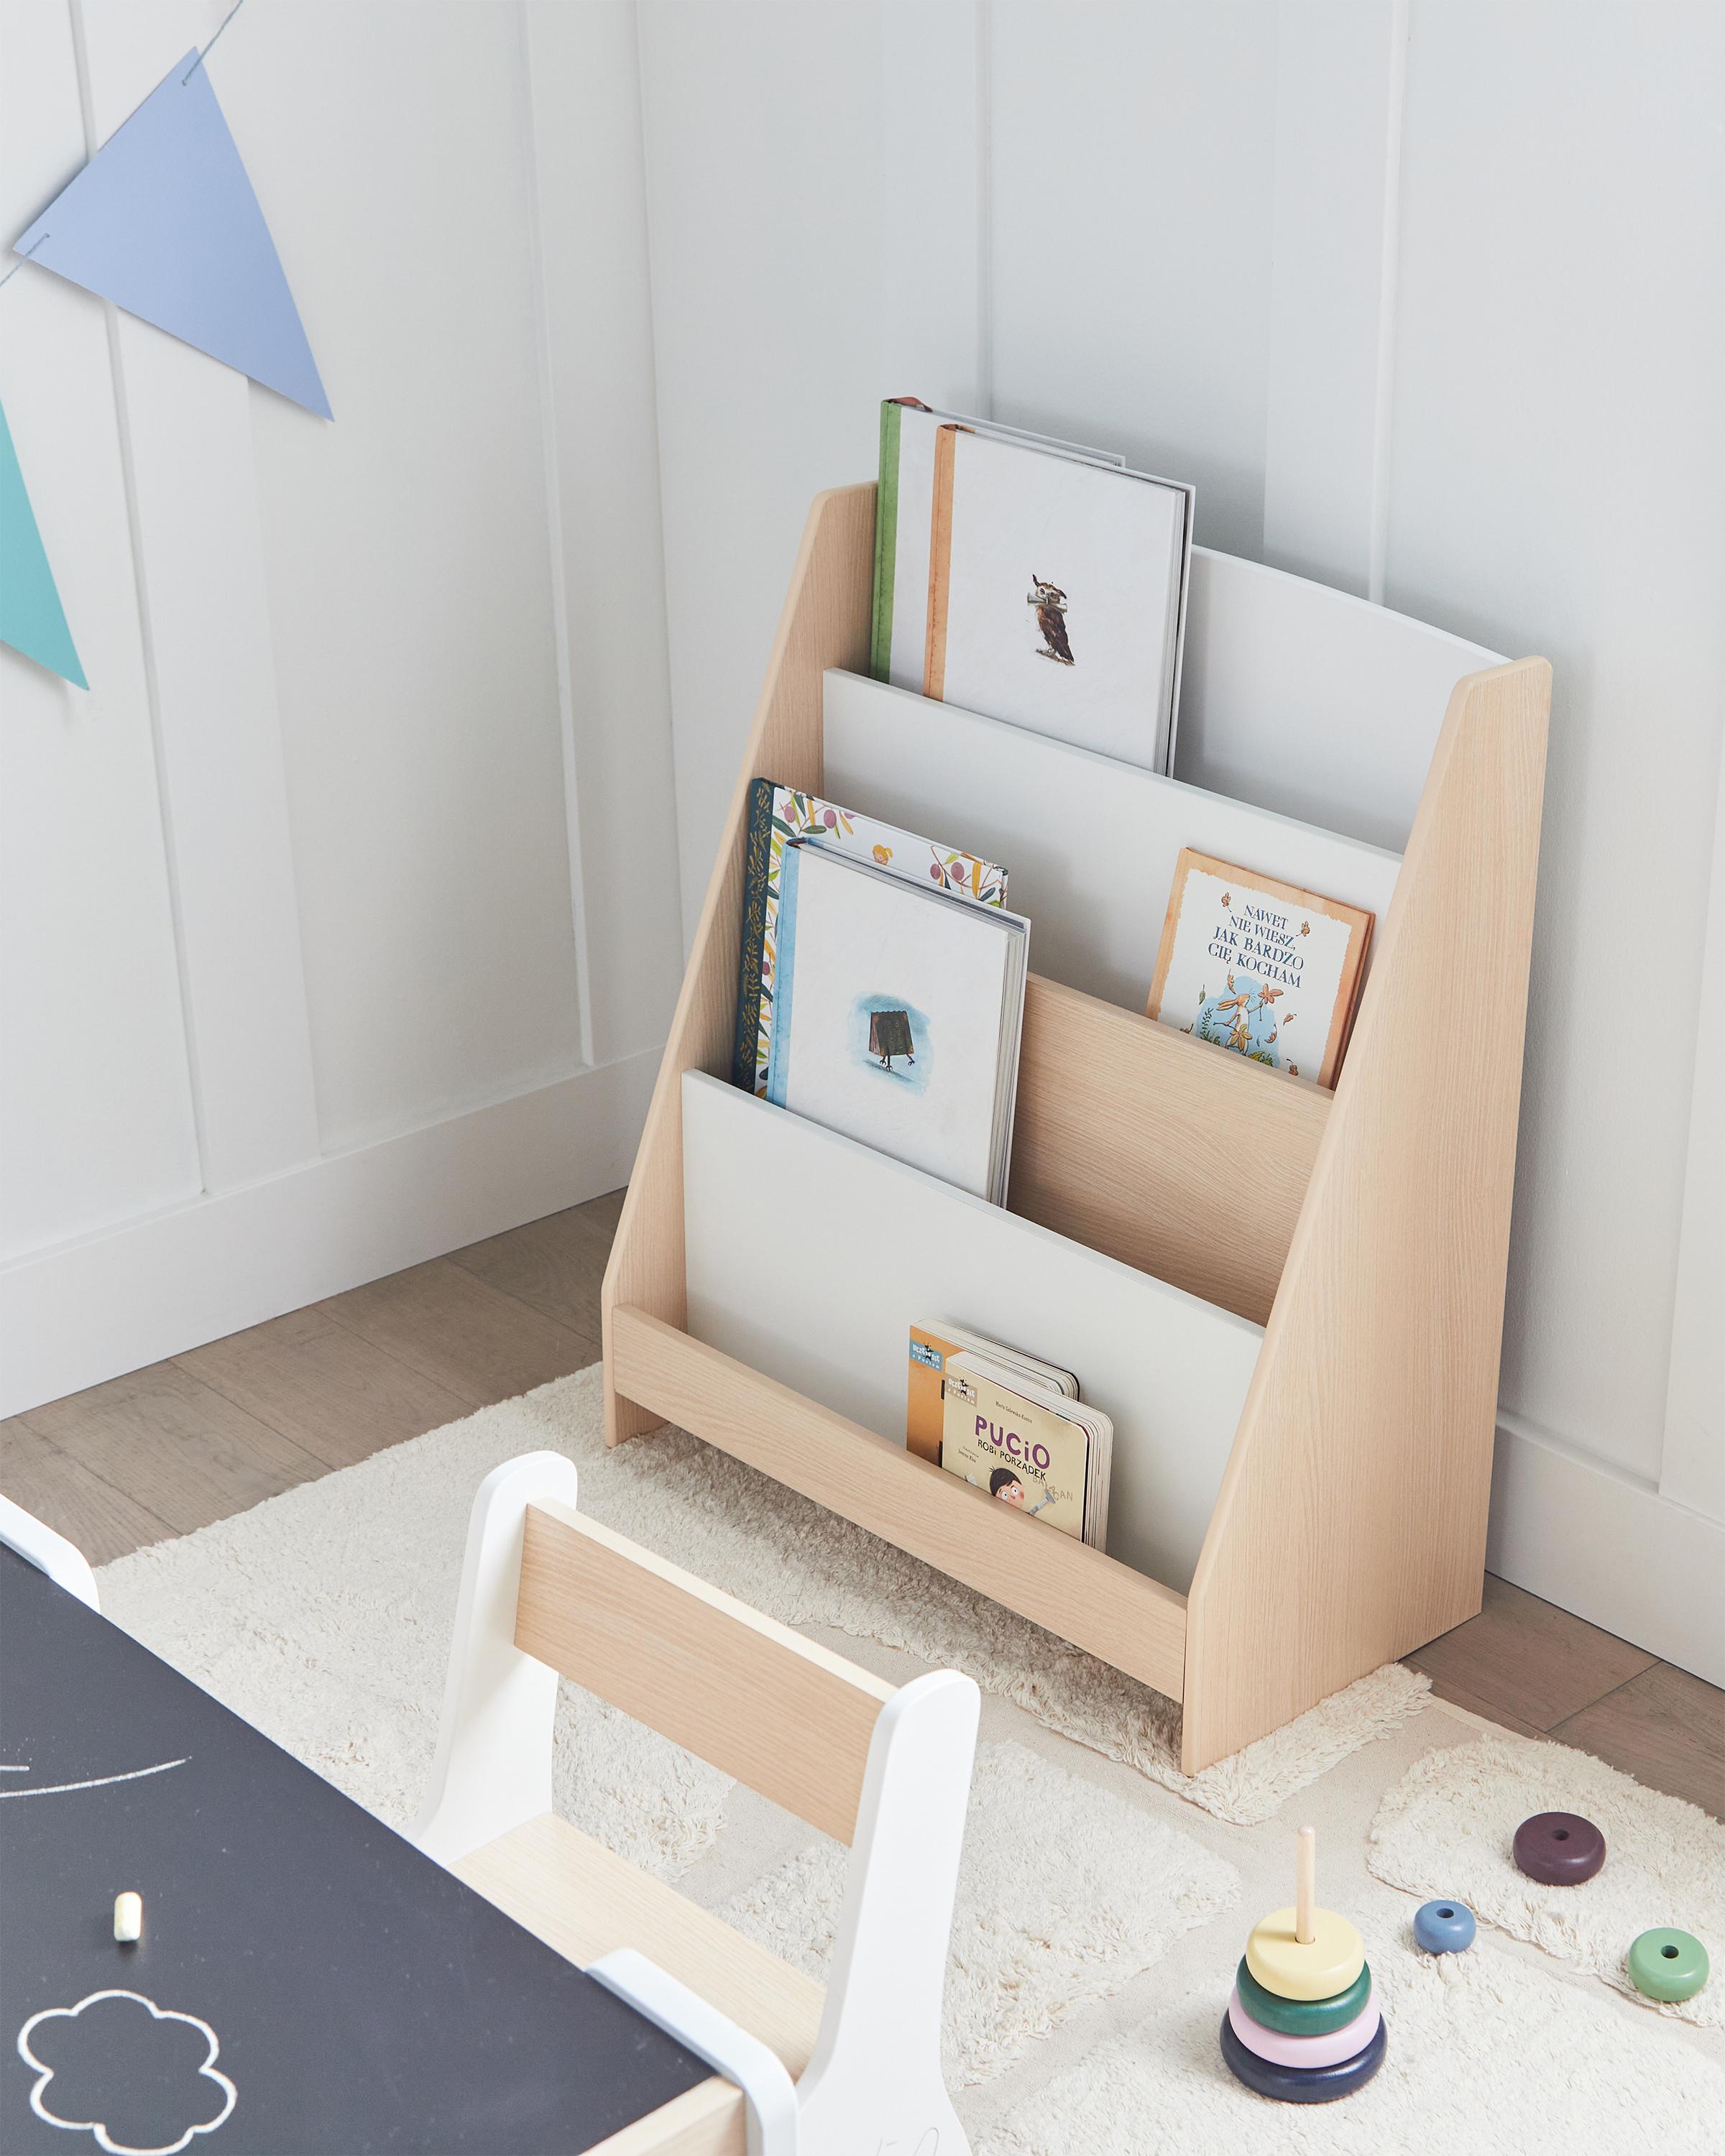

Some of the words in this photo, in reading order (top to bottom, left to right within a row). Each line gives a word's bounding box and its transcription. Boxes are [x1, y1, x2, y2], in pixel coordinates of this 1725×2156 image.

[1228, 915, 1251, 933] NIE
[1254, 923, 1296, 951] WIESZ,
[1243, 904, 1289, 930] NAWET
[1208, 942, 1232, 964] CIĘ
[1236, 952, 1302, 988] KOCHAM
[1213, 926, 1238, 946] JAK
[1243, 936, 1304, 970] BARDZO
